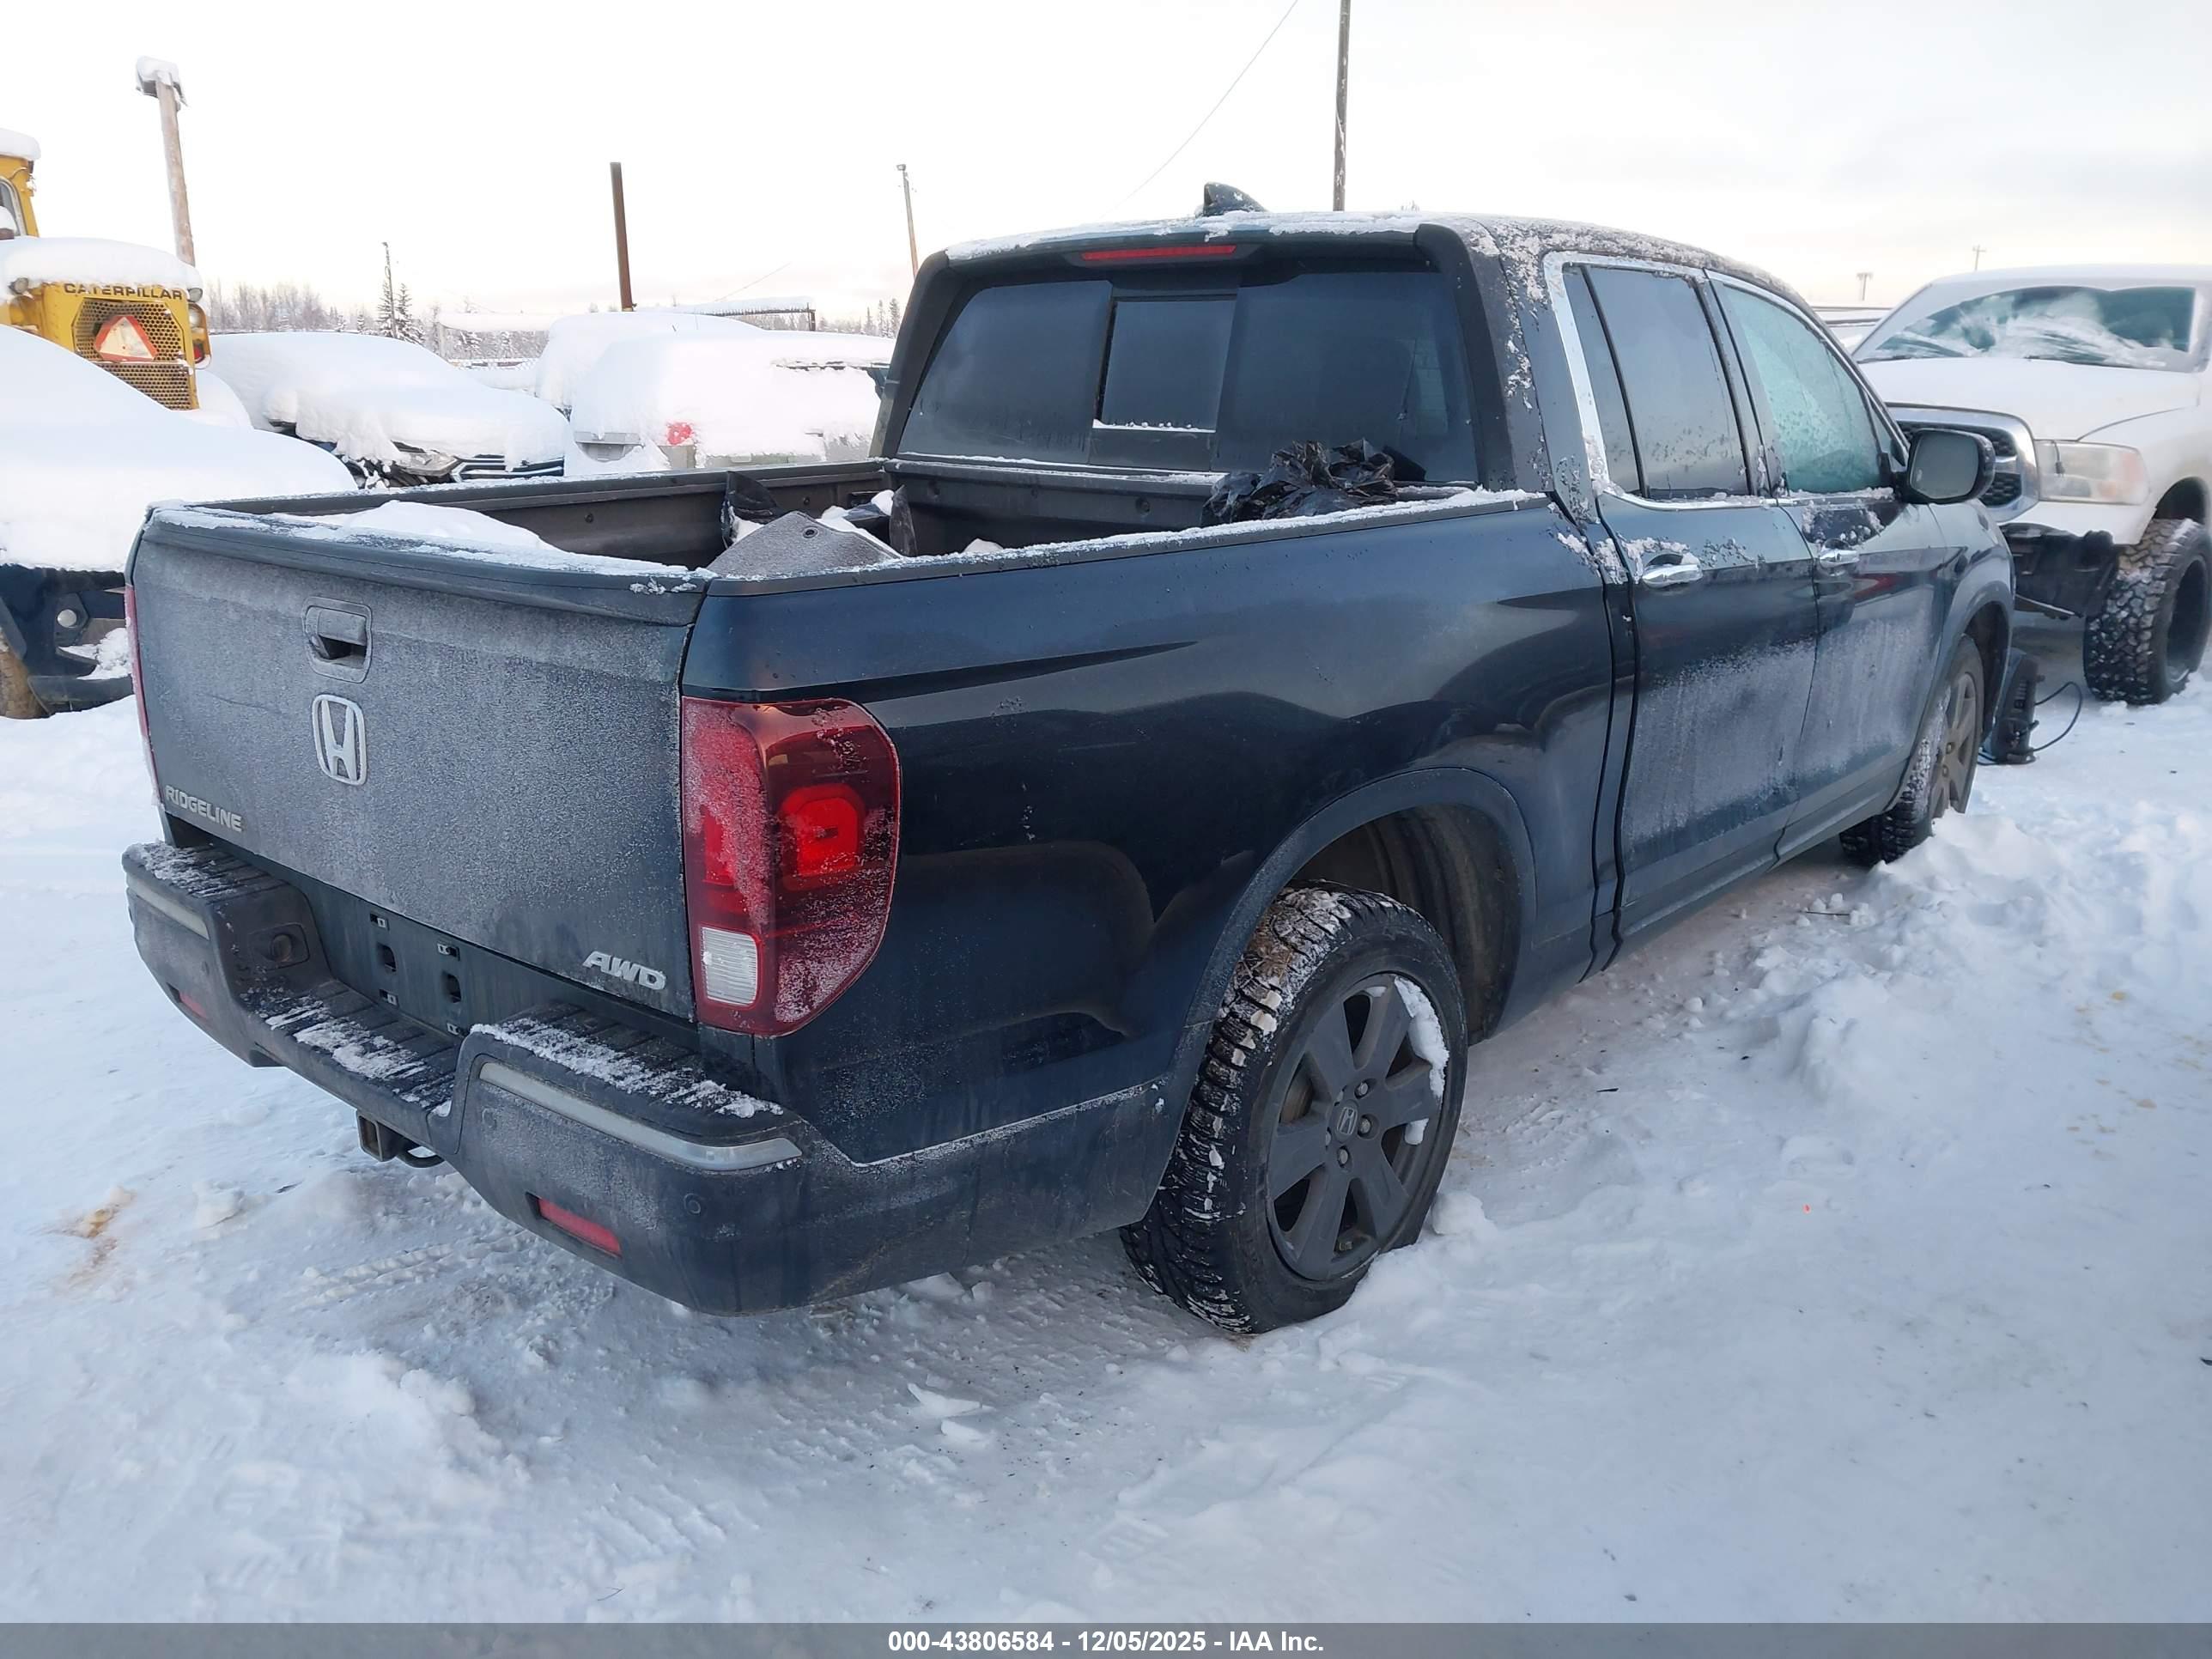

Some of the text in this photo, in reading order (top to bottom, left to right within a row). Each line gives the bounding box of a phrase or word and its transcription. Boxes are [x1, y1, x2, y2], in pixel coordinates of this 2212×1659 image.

[64, 283, 183, 300] CATERPILLAR
[165, 785, 243, 832] RIDGELINE
[582, 951, 666, 990] AWD
